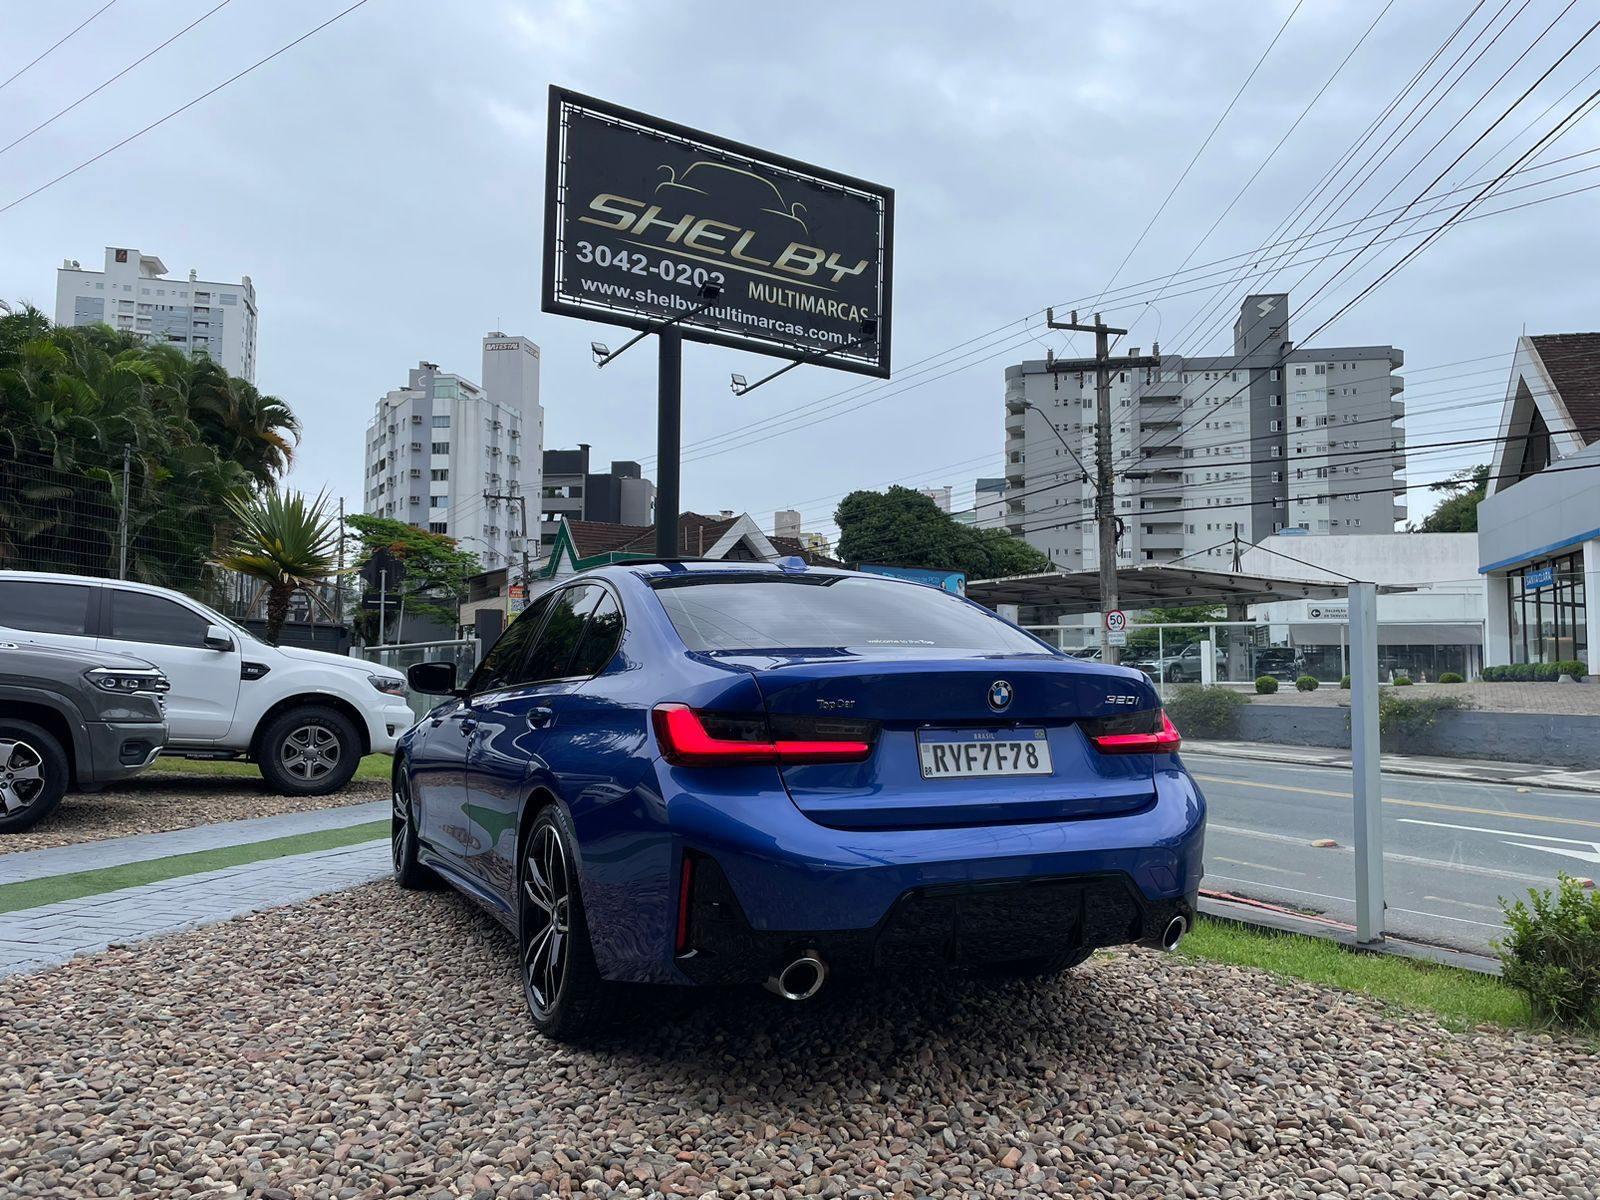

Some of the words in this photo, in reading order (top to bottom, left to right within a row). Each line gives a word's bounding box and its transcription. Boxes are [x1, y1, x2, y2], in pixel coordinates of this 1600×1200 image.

[577, 193, 869, 283] SHELBY
[748, 281, 869, 323] MULTIMARCAS
[1110, 615, 1122, 625] 50
[932, 743, 1039, 772] RYF7F78
